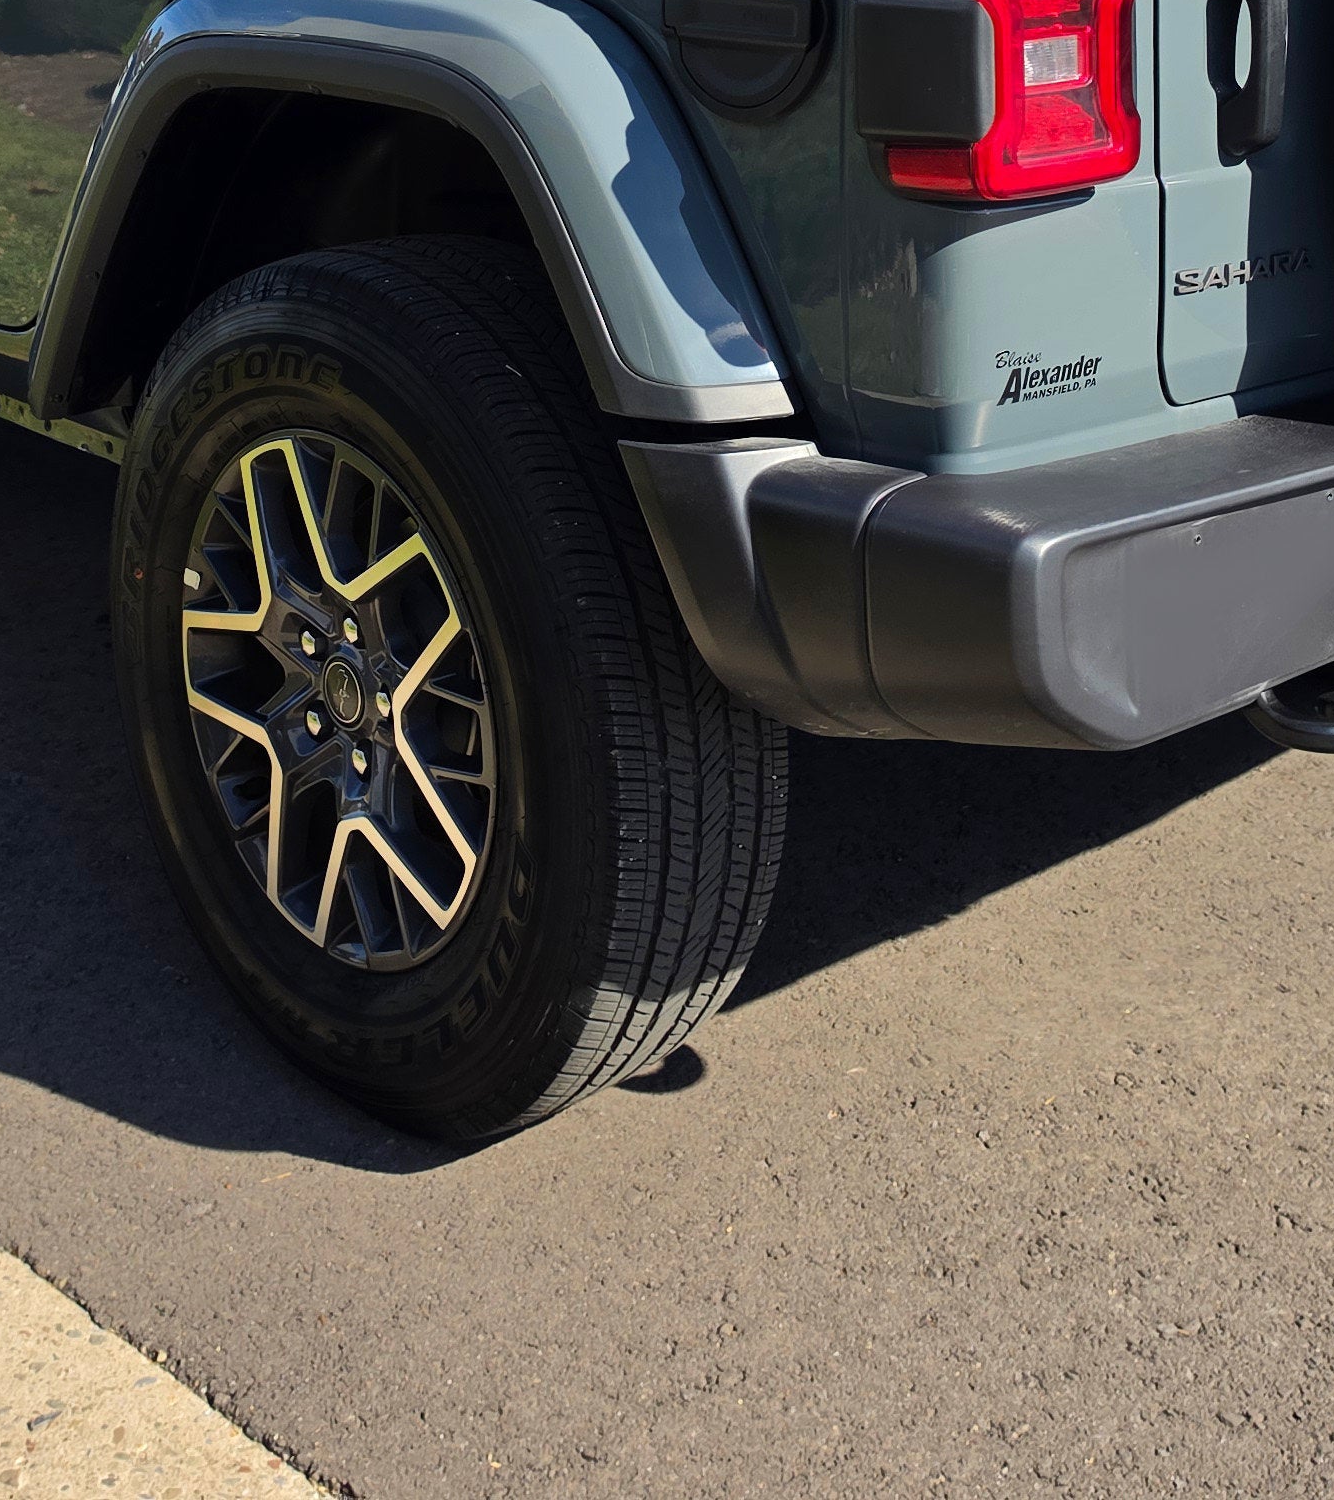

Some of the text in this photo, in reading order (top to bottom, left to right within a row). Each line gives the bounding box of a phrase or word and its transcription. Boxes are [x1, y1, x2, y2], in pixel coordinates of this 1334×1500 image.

[1173, 248, 1313, 296] SAHARA
[995, 350, 1042, 369] Blaise
[996, 355, 1102, 406] Alexander
[1022, 377, 1097, 402] MANSFIELD, PA
